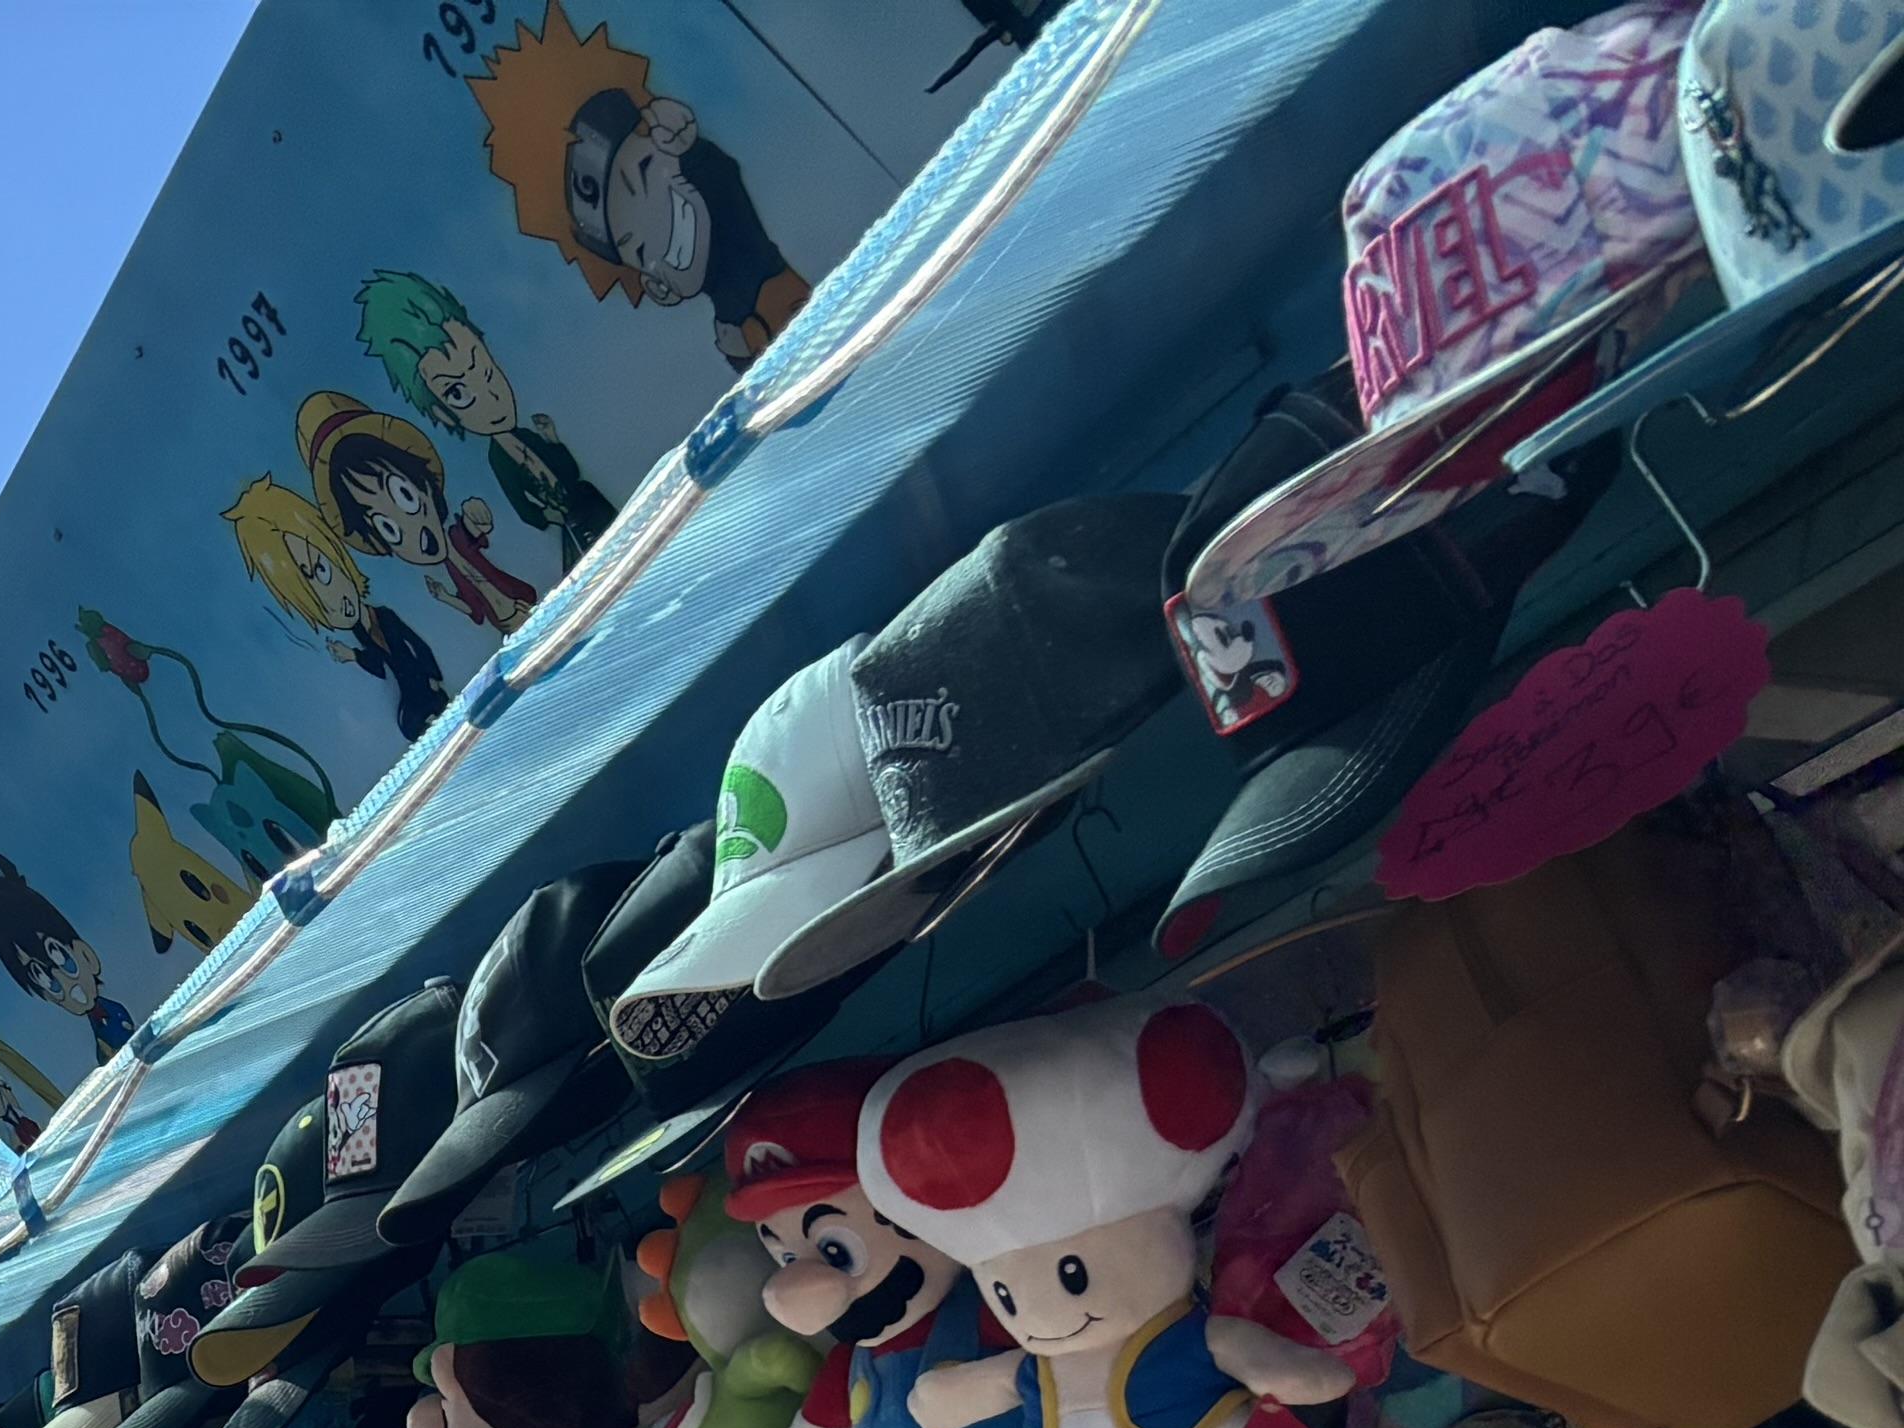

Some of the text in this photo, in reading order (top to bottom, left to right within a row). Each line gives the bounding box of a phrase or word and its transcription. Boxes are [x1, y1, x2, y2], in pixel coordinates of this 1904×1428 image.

[1345, 165, 1537, 415] RVEL
[217, 291, 288, 396] 1997
[23, 639, 78, 714] 1996
